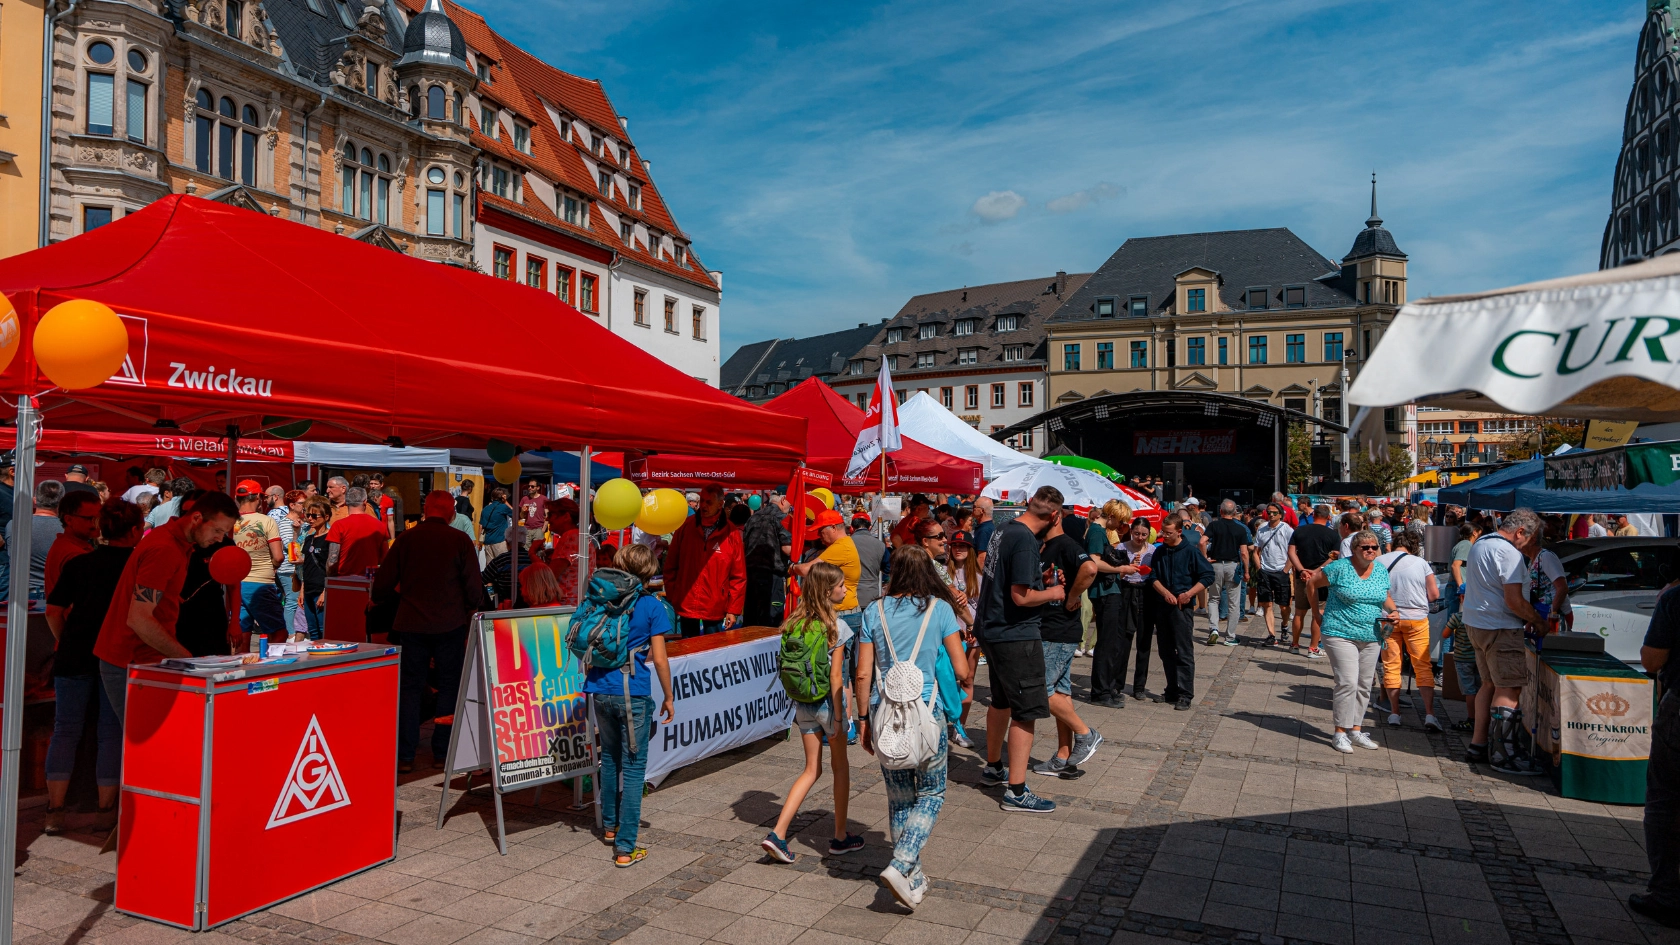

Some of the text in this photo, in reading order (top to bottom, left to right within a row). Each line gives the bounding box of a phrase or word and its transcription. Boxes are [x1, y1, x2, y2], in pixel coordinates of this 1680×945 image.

[1491, 315, 1680, 379] CUR
[168, 362, 272, 397] Zwickau
[1136, 435, 1233, 454] MEHR LOHN
[491, 680, 538, 709] hast
[663, 704, 743, 751] HUMANS
[1567, 721, 1649, 734] HOPFENKRONE
[1587, 732, 1631, 748] Original
[501, 767, 545, 785] Kommunal-
[545, 768, 551, 776] &
